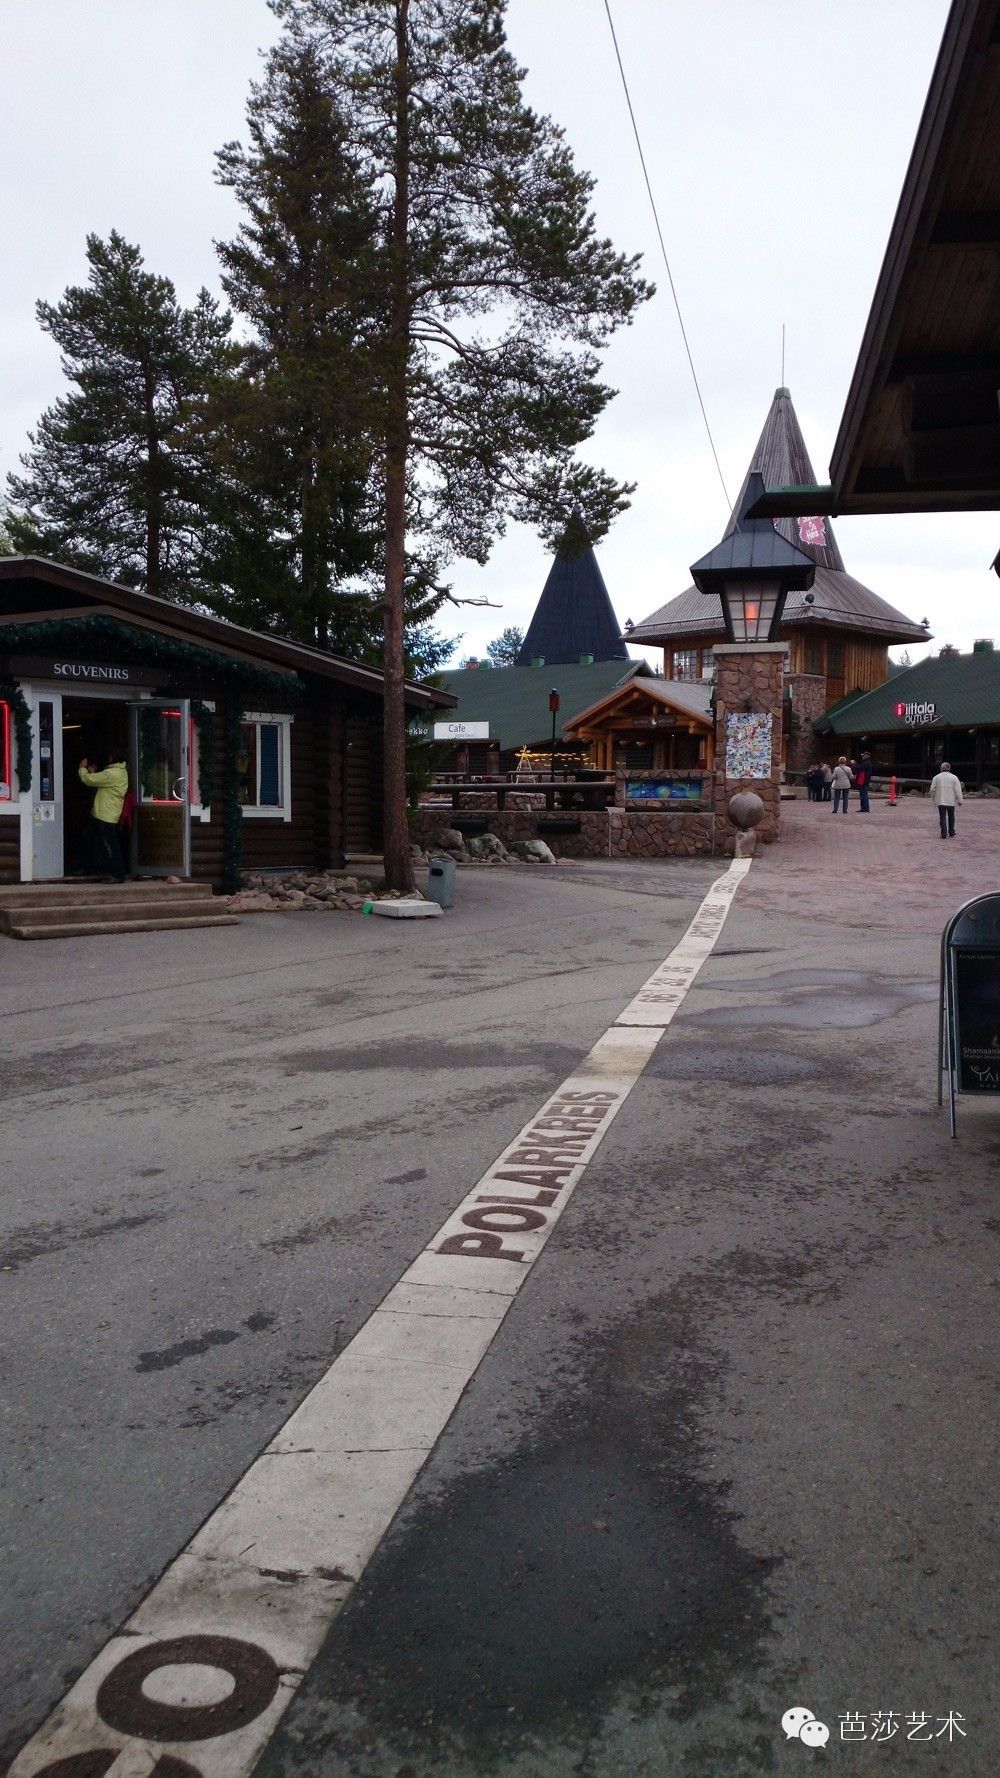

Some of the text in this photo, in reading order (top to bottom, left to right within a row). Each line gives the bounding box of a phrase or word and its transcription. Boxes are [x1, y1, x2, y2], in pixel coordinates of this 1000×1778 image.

[53, 663, 129, 679] SOUVENIRS
[905, 713, 934, 724] OUTLET
[405, 727, 428, 735] ekko
[448, 724, 466, 733] Cafe
[434, 1090, 620, 1263] POLARKREIS
